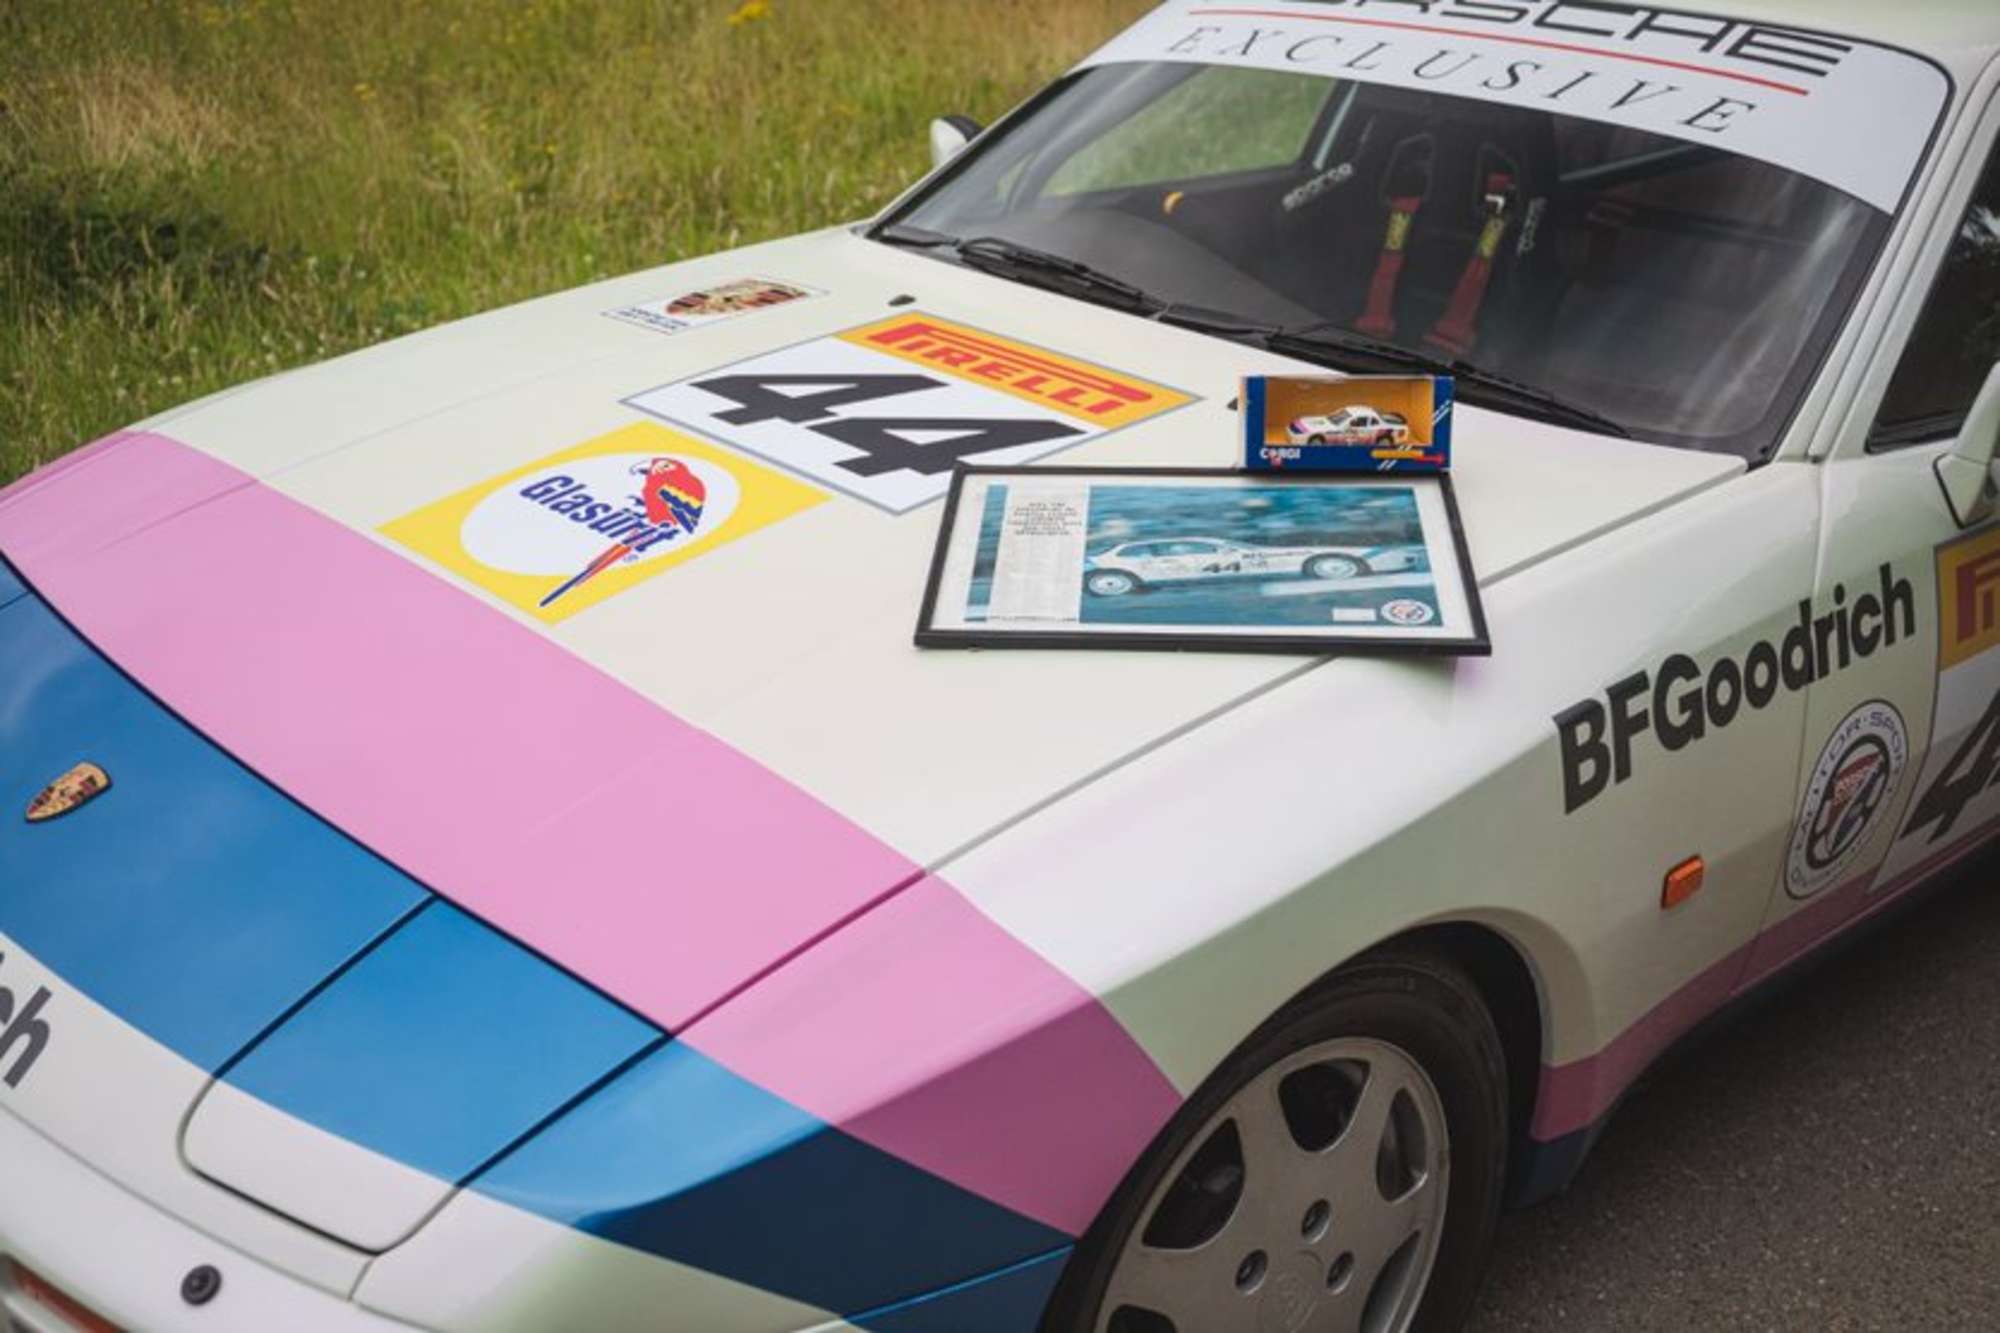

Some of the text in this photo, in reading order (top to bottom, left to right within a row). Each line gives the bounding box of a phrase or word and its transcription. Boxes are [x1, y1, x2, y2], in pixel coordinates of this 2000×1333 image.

[1165, 26, 1757, 133] EXCLUSIVE
[866, 322, 1153, 414] PIRELLI
[688, 373, 1088, 478] 44
[519, 474, 681, 552] Glasurit
[1553, 562, 1915, 815] BFGoodrich
